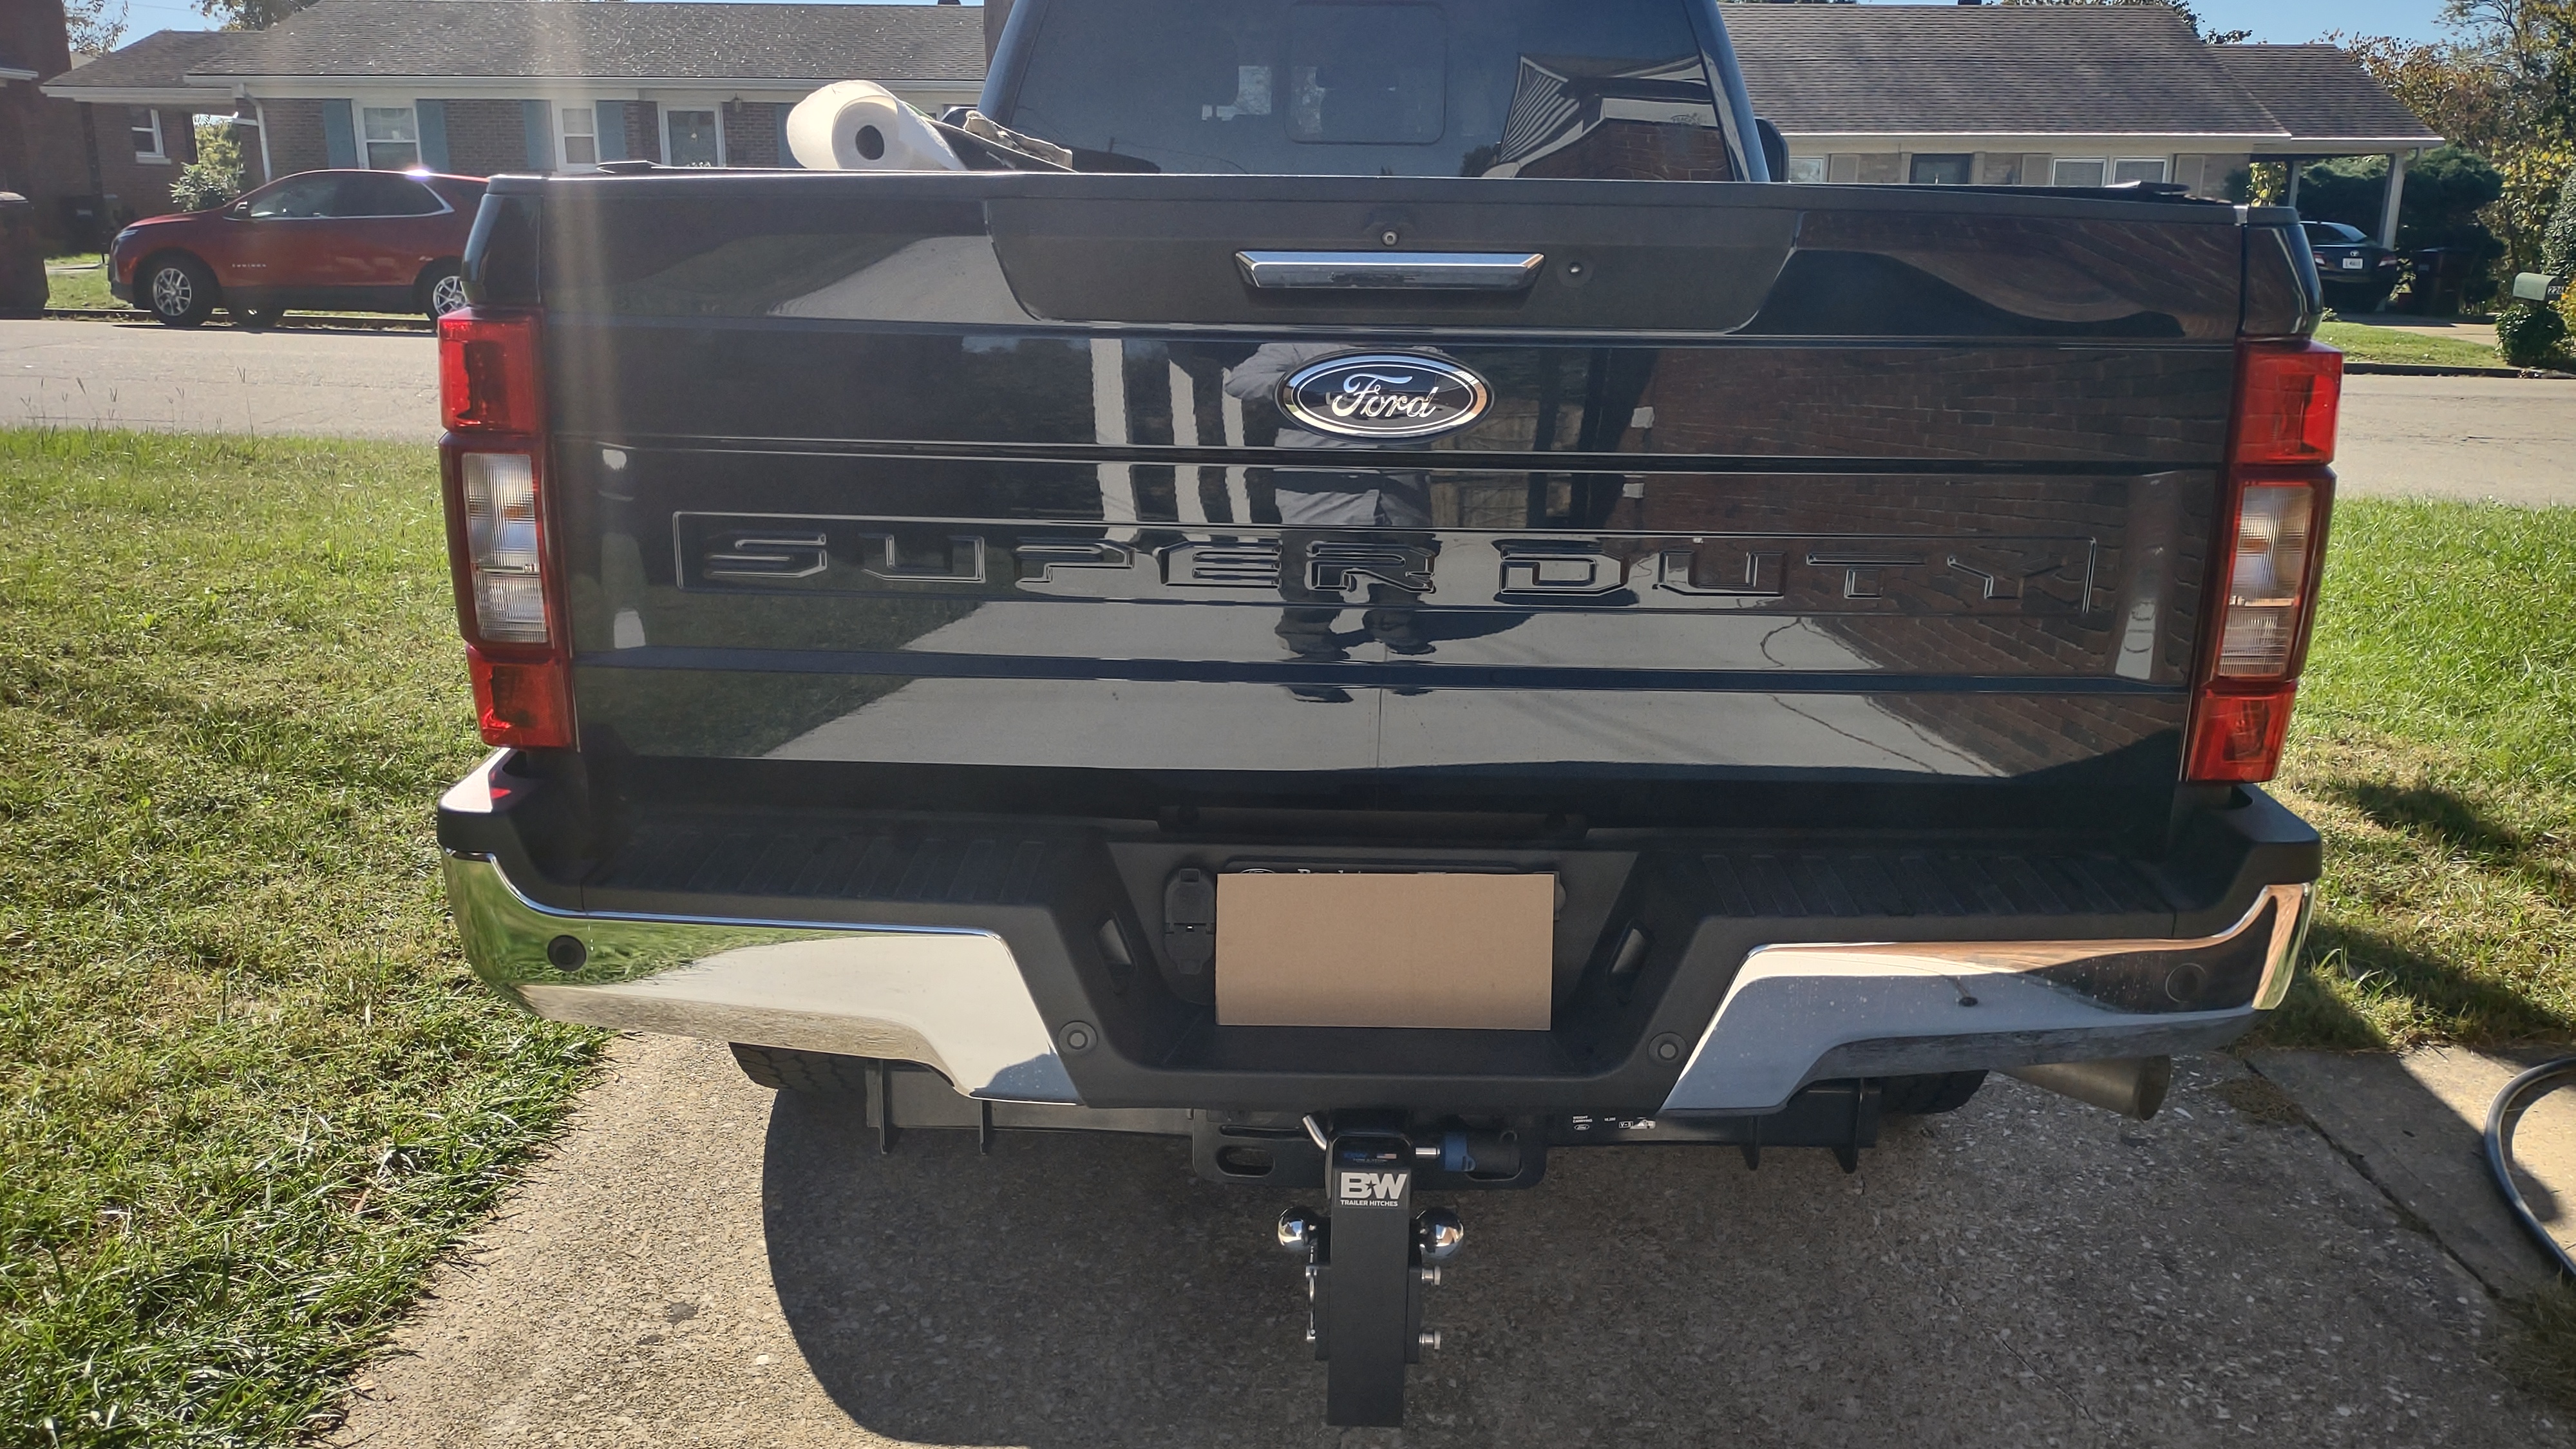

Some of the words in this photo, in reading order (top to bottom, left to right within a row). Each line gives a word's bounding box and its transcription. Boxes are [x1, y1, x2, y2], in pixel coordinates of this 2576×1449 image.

[1331, 373, 1439, 417] Ford
[705, 529, 1437, 593] SUPER
[1499, 547, 2069, 600] DUTY
